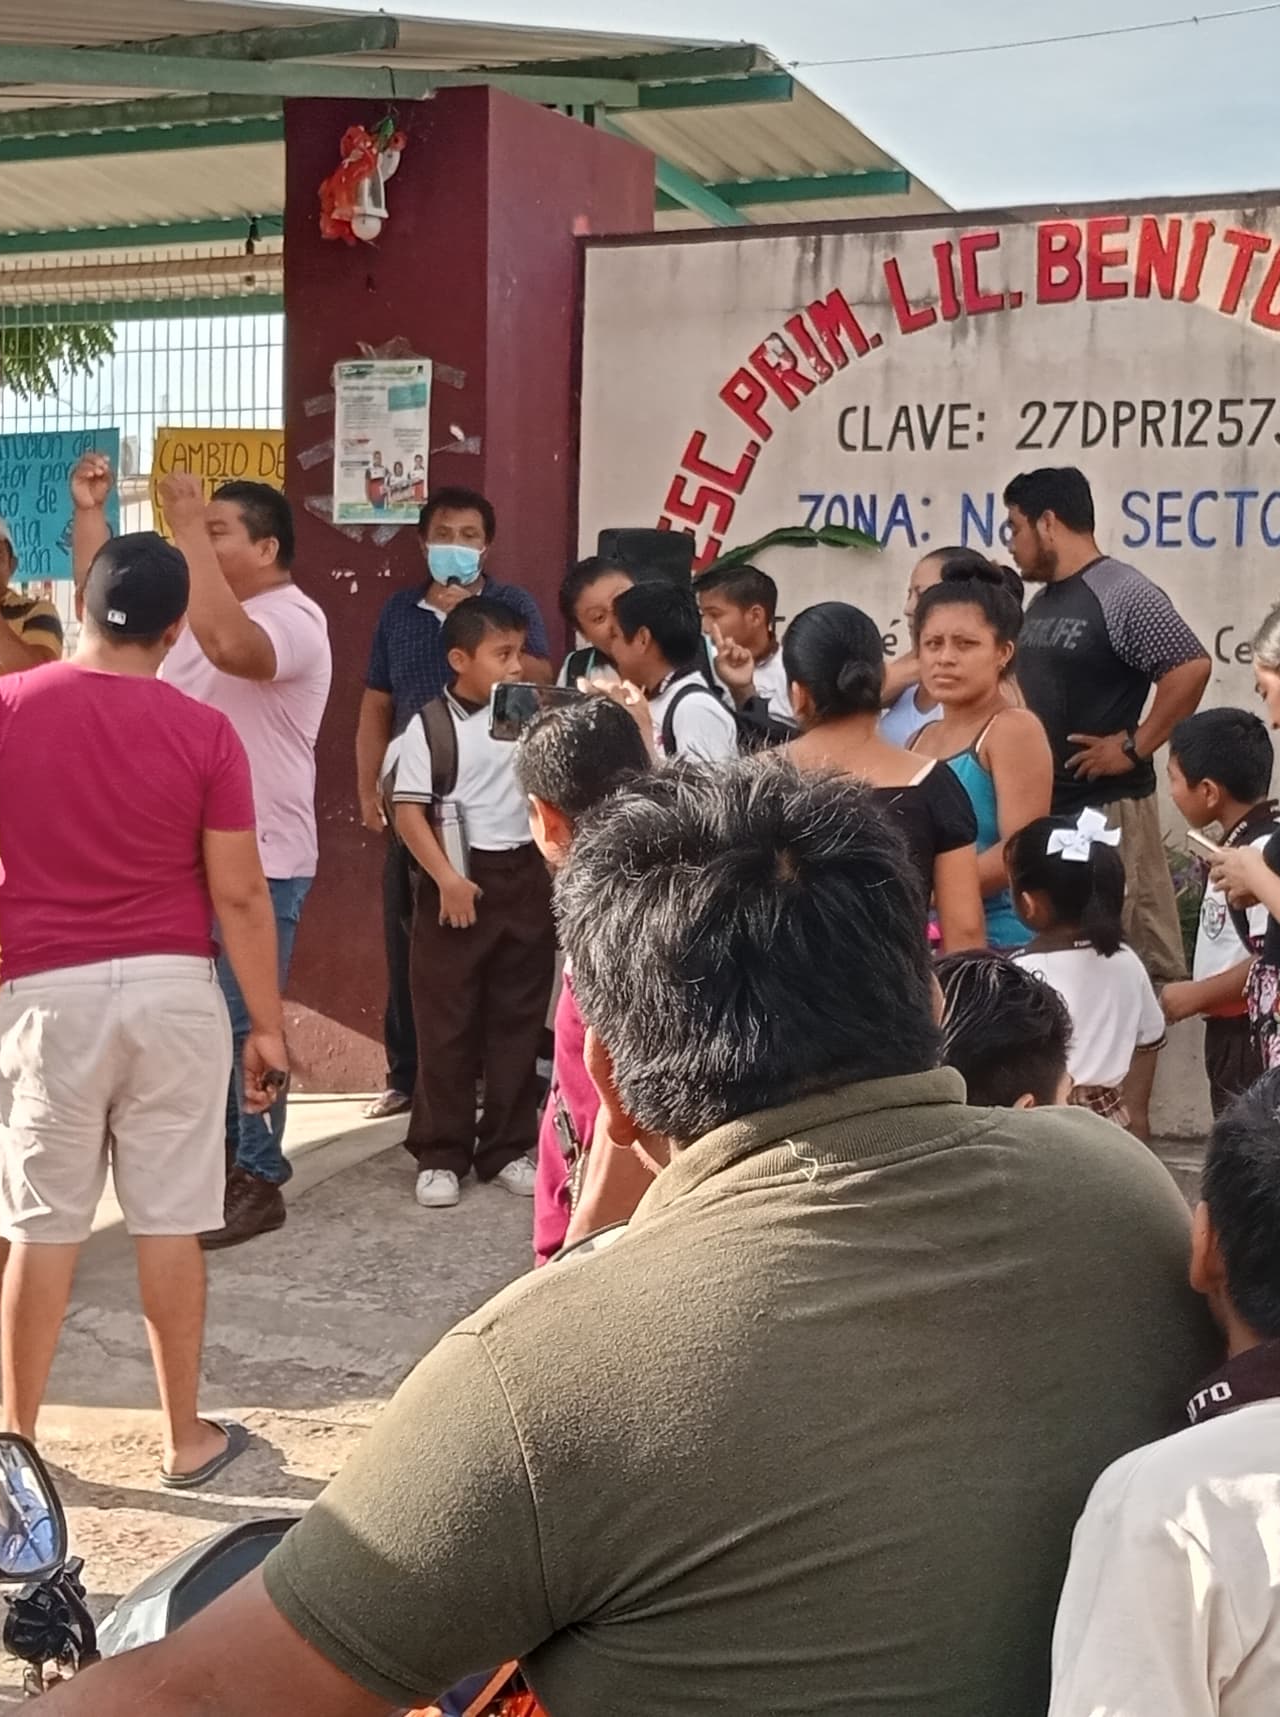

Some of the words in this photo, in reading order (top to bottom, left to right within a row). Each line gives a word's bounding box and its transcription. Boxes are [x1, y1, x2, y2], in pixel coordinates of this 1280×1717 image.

[719, 288, 883, 442] PRIM.
[883, 232, 1022, 335] LIC.
[838, 404, 986, 452] CLAVE:
[160, 439, 249, 477] CAMBIO
[39, 462, 73, 495] por
[36, 485, 58, 515] de
